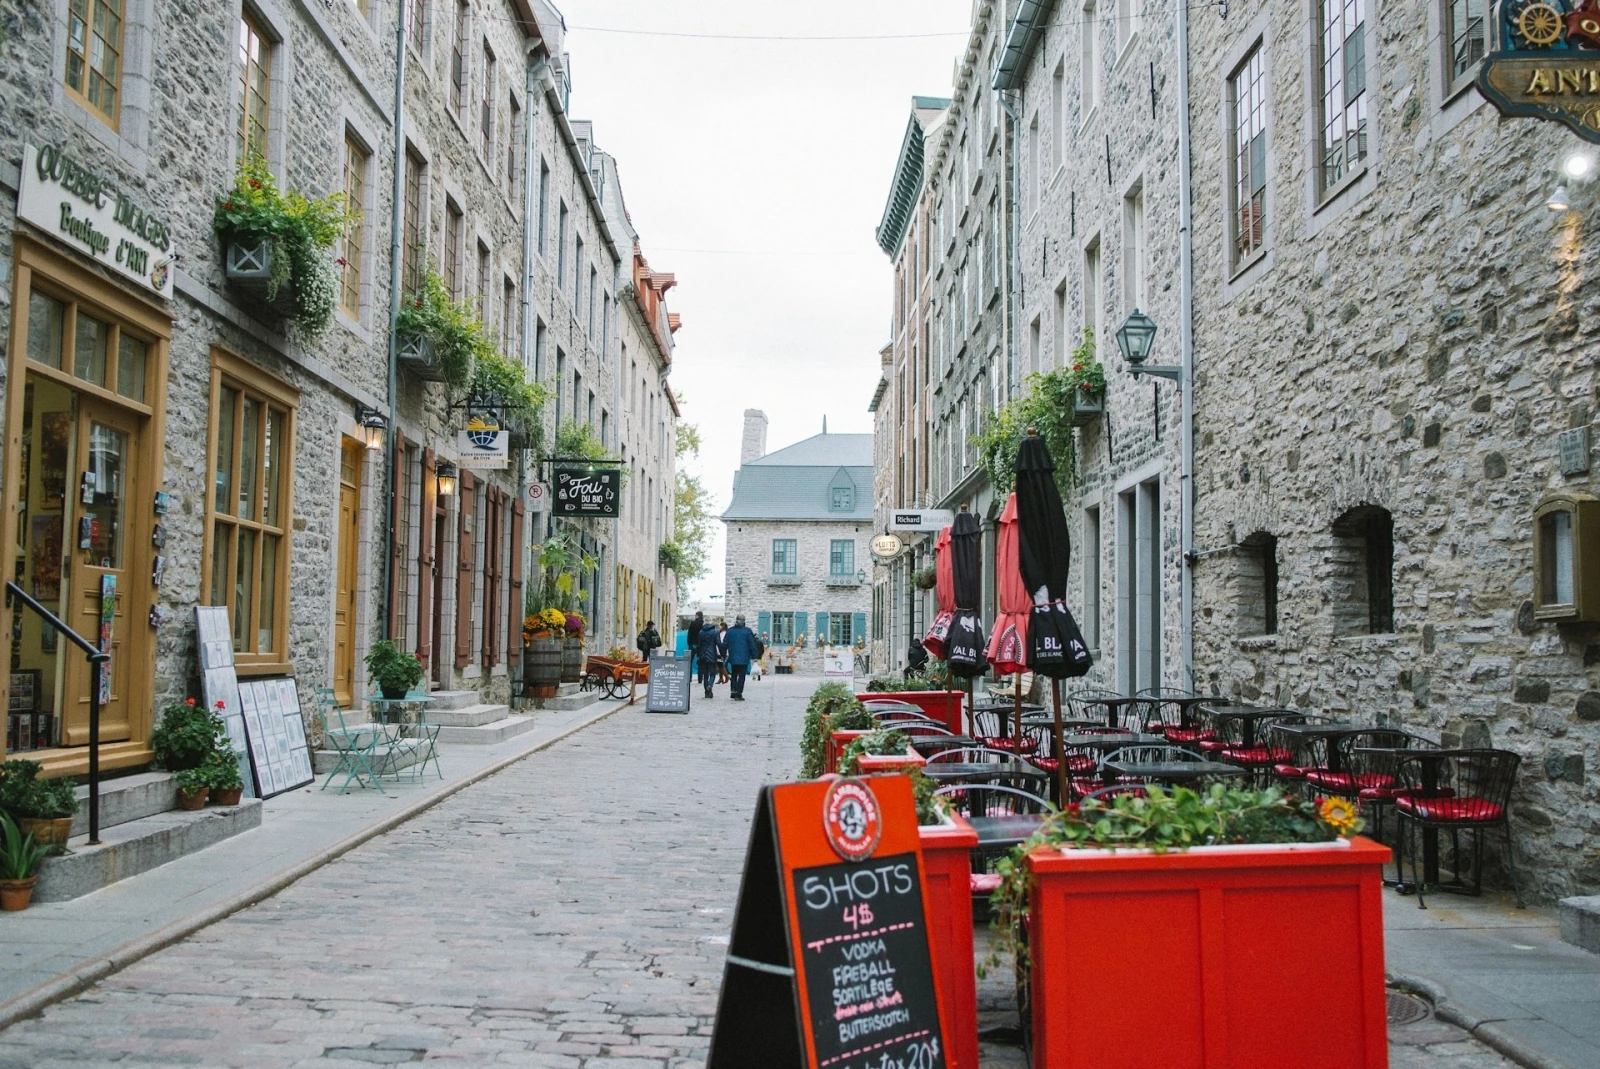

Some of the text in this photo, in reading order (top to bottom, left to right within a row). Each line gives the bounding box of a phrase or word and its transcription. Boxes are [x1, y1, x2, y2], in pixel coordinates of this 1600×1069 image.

[60, 201, 109, 256] Boutique
[112, 194, 171, 252] IMAGES
[569, 475, 603, 498] Fou
[581, 495, 603, 503] DU BIO
[803, 864, 913, 910] SHOTS
[843, 903, 874, 930] 4$
[841, 938, 887, 961] VODKA
[838, 1008, 911, 1043] BUTTERSCOTCH
